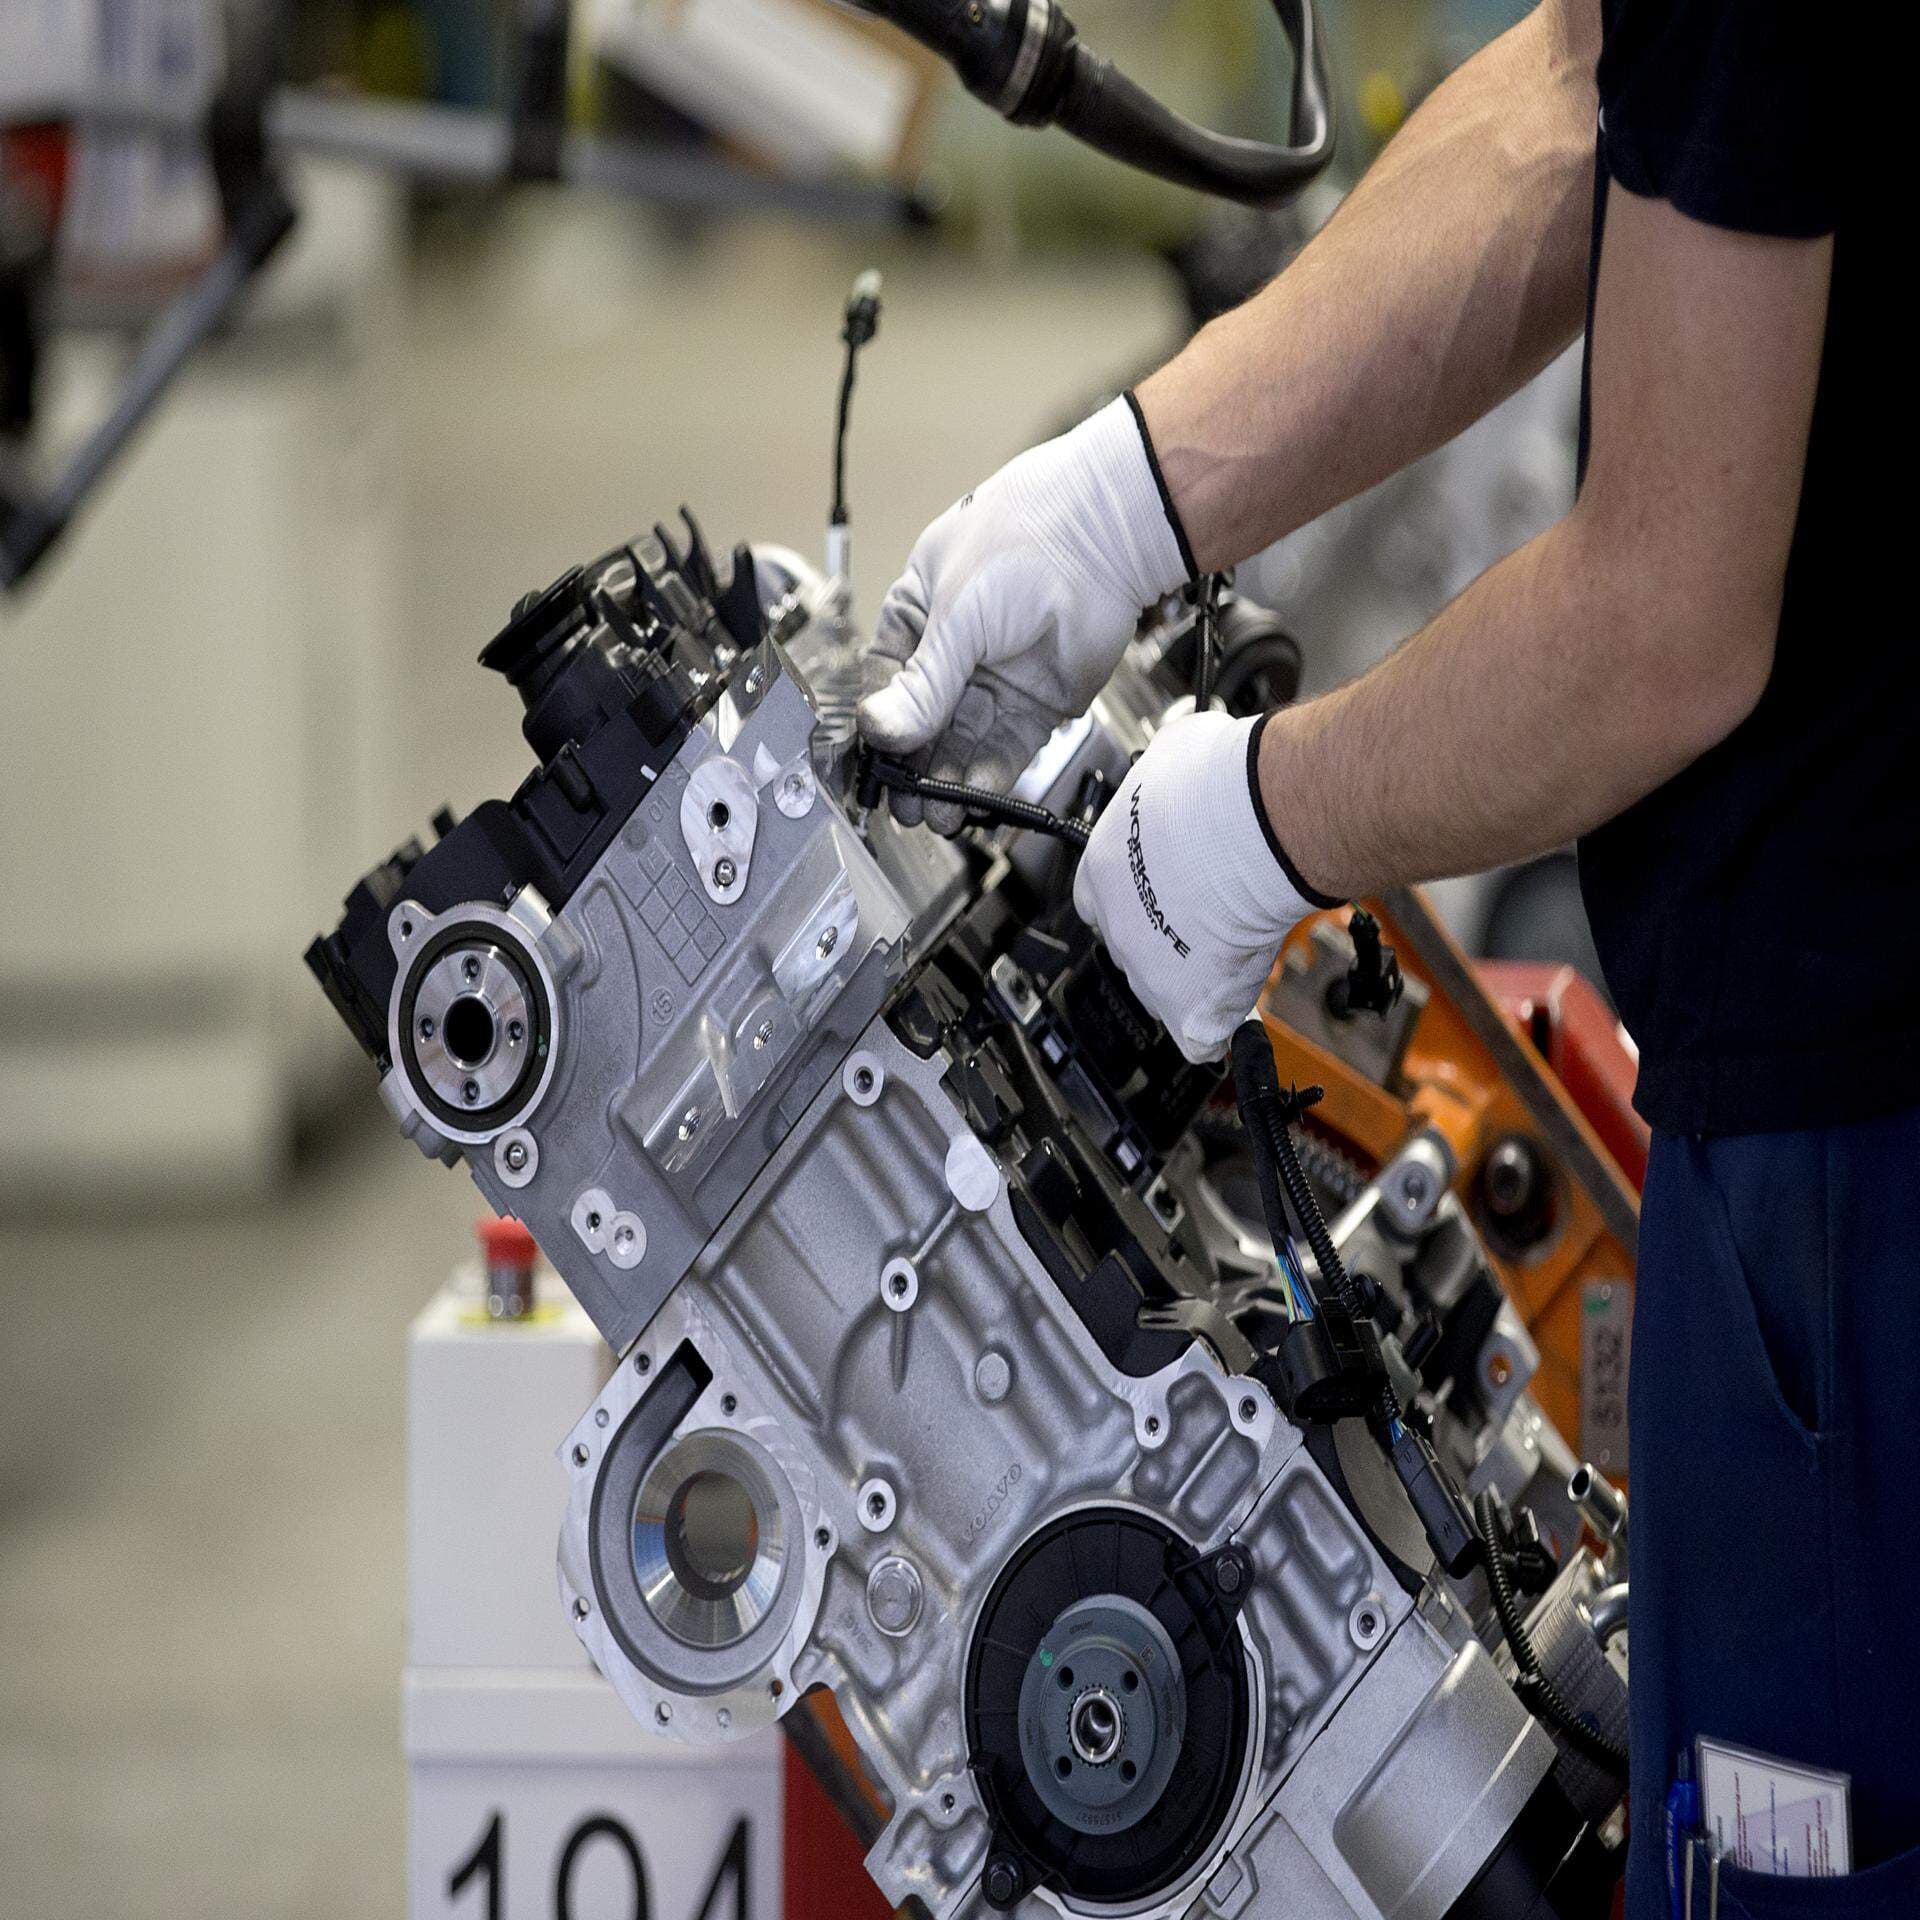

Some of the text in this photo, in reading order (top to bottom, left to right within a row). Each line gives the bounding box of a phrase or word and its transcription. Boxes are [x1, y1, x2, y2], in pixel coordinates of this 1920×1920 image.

[1126, 838, 1159, 931] precision
[1130, 783, 1191, 959] WORKSAFE
[961, 1463, 1022, 1547] VOLVO
[448, 1811, 753, 1920] 104
